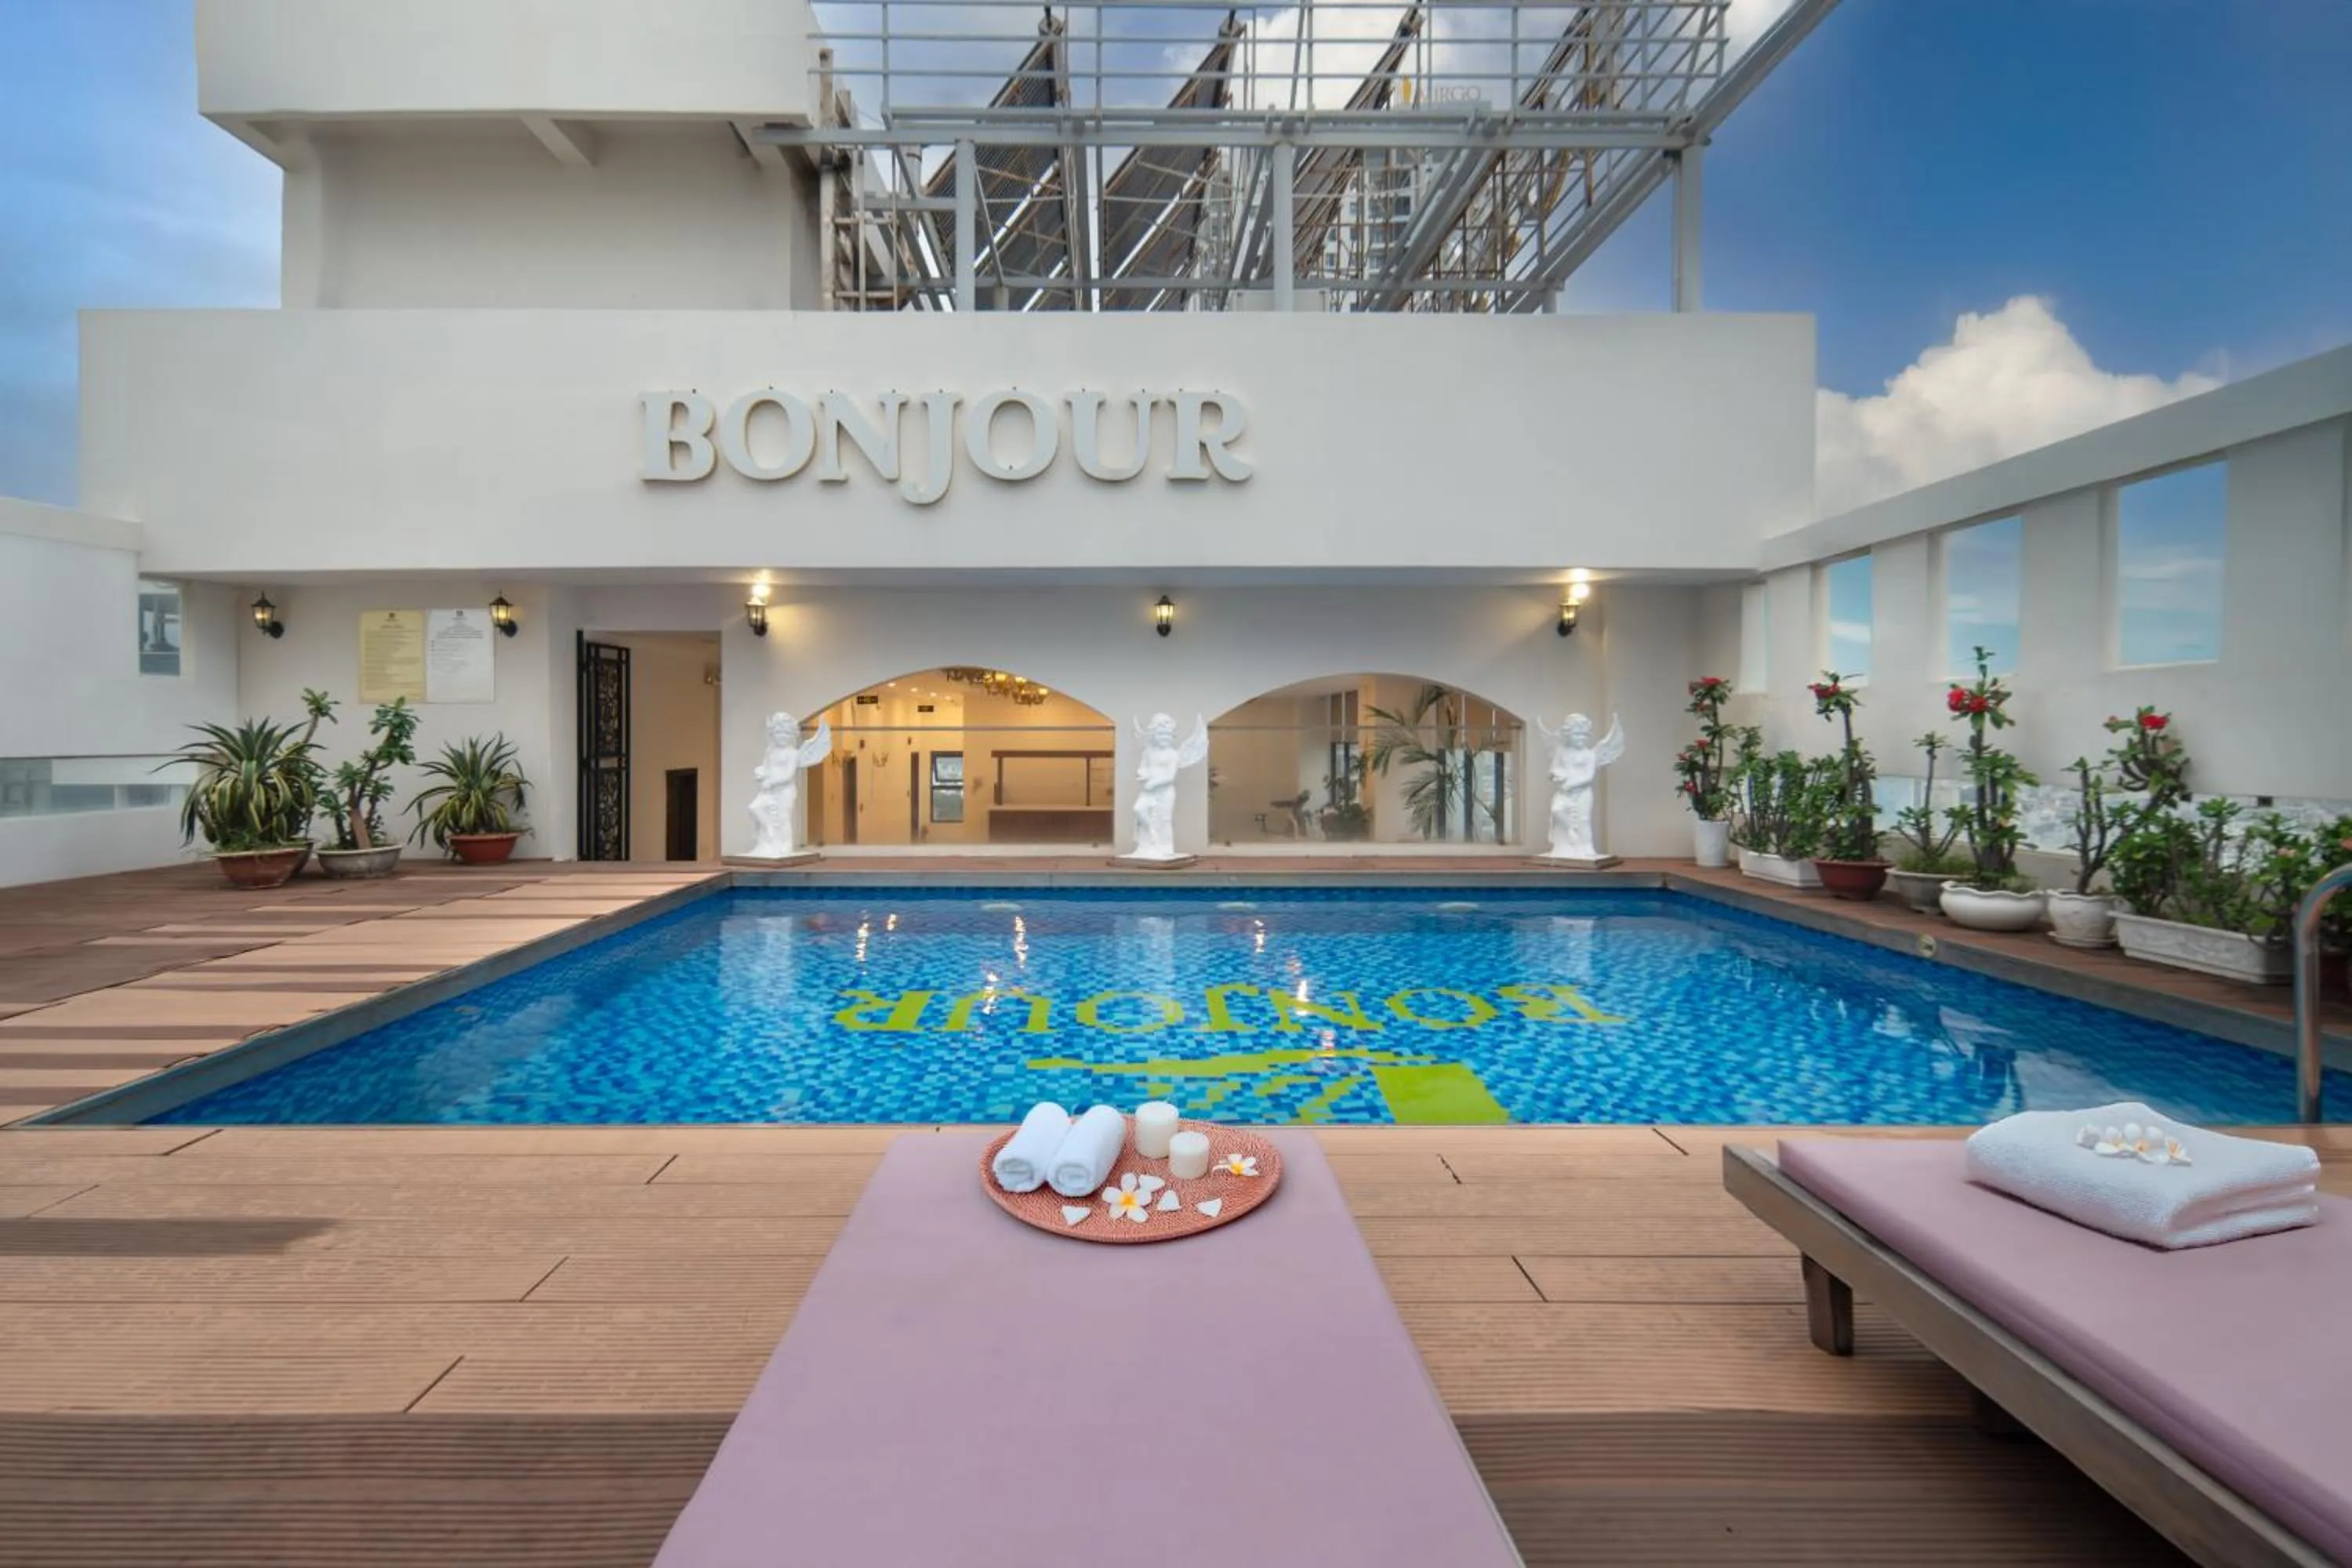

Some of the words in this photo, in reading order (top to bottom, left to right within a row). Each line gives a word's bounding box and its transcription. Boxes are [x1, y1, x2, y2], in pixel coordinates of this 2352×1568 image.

[1421, 85, 1480, 101] IRGO
[639, 387, 1254, 504] BONJOUR
[833, 982, 1632, 1033] BONJOUR
